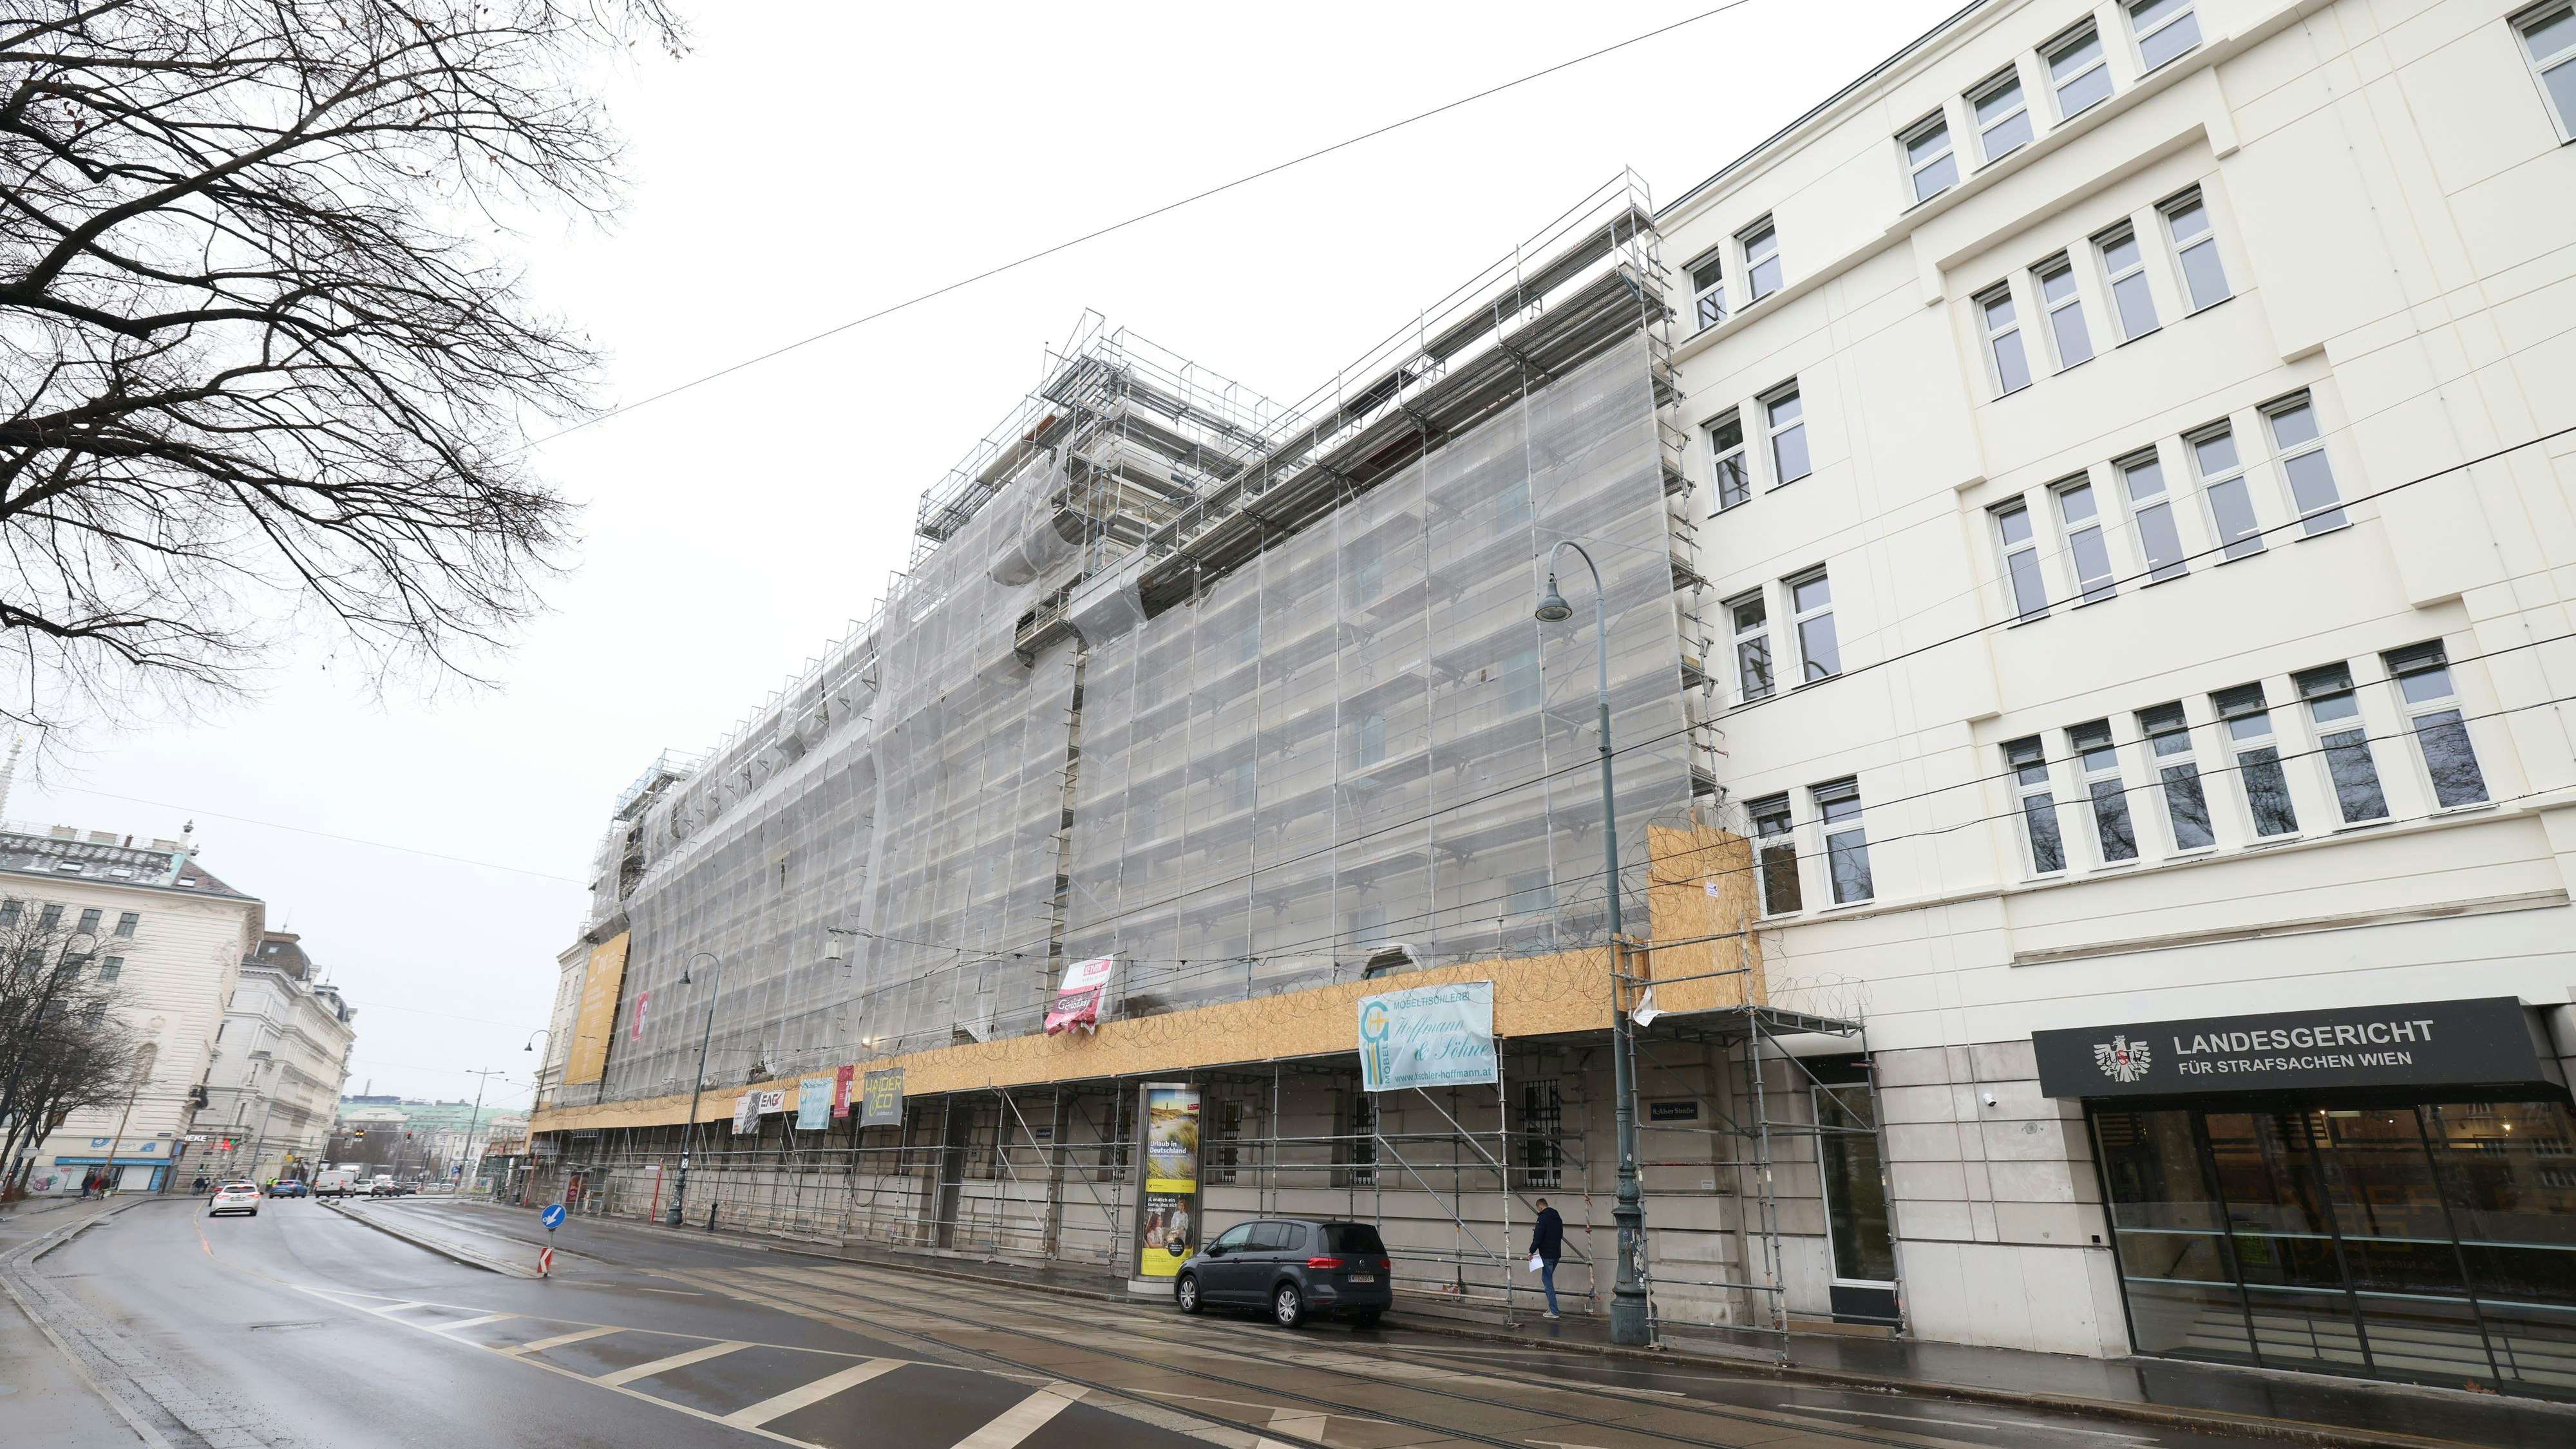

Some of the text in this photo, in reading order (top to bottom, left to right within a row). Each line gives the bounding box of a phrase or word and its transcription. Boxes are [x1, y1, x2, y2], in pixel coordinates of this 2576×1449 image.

[1084, 962, 1103, 974] XERVON
[1393, 992, 1470, 1010] MÖBELTISCHLEREI
[1392, 1014, 1464, 1044] Hoffmann
[2173, 1019, 2434, 1055] LANDESGERICHT
[1414, 1034, 1489, 1061] & Söhne
[1381, 1041, 1391, 1084] MÖBEL
[2178, 1051, 2412, 1075] FÜR STRAFSACHEN WIEN
[865, 1076, 902, 1094] HAIDER
[1395, 1067, 1492, 1083] www.tischler-hoffmann.at
